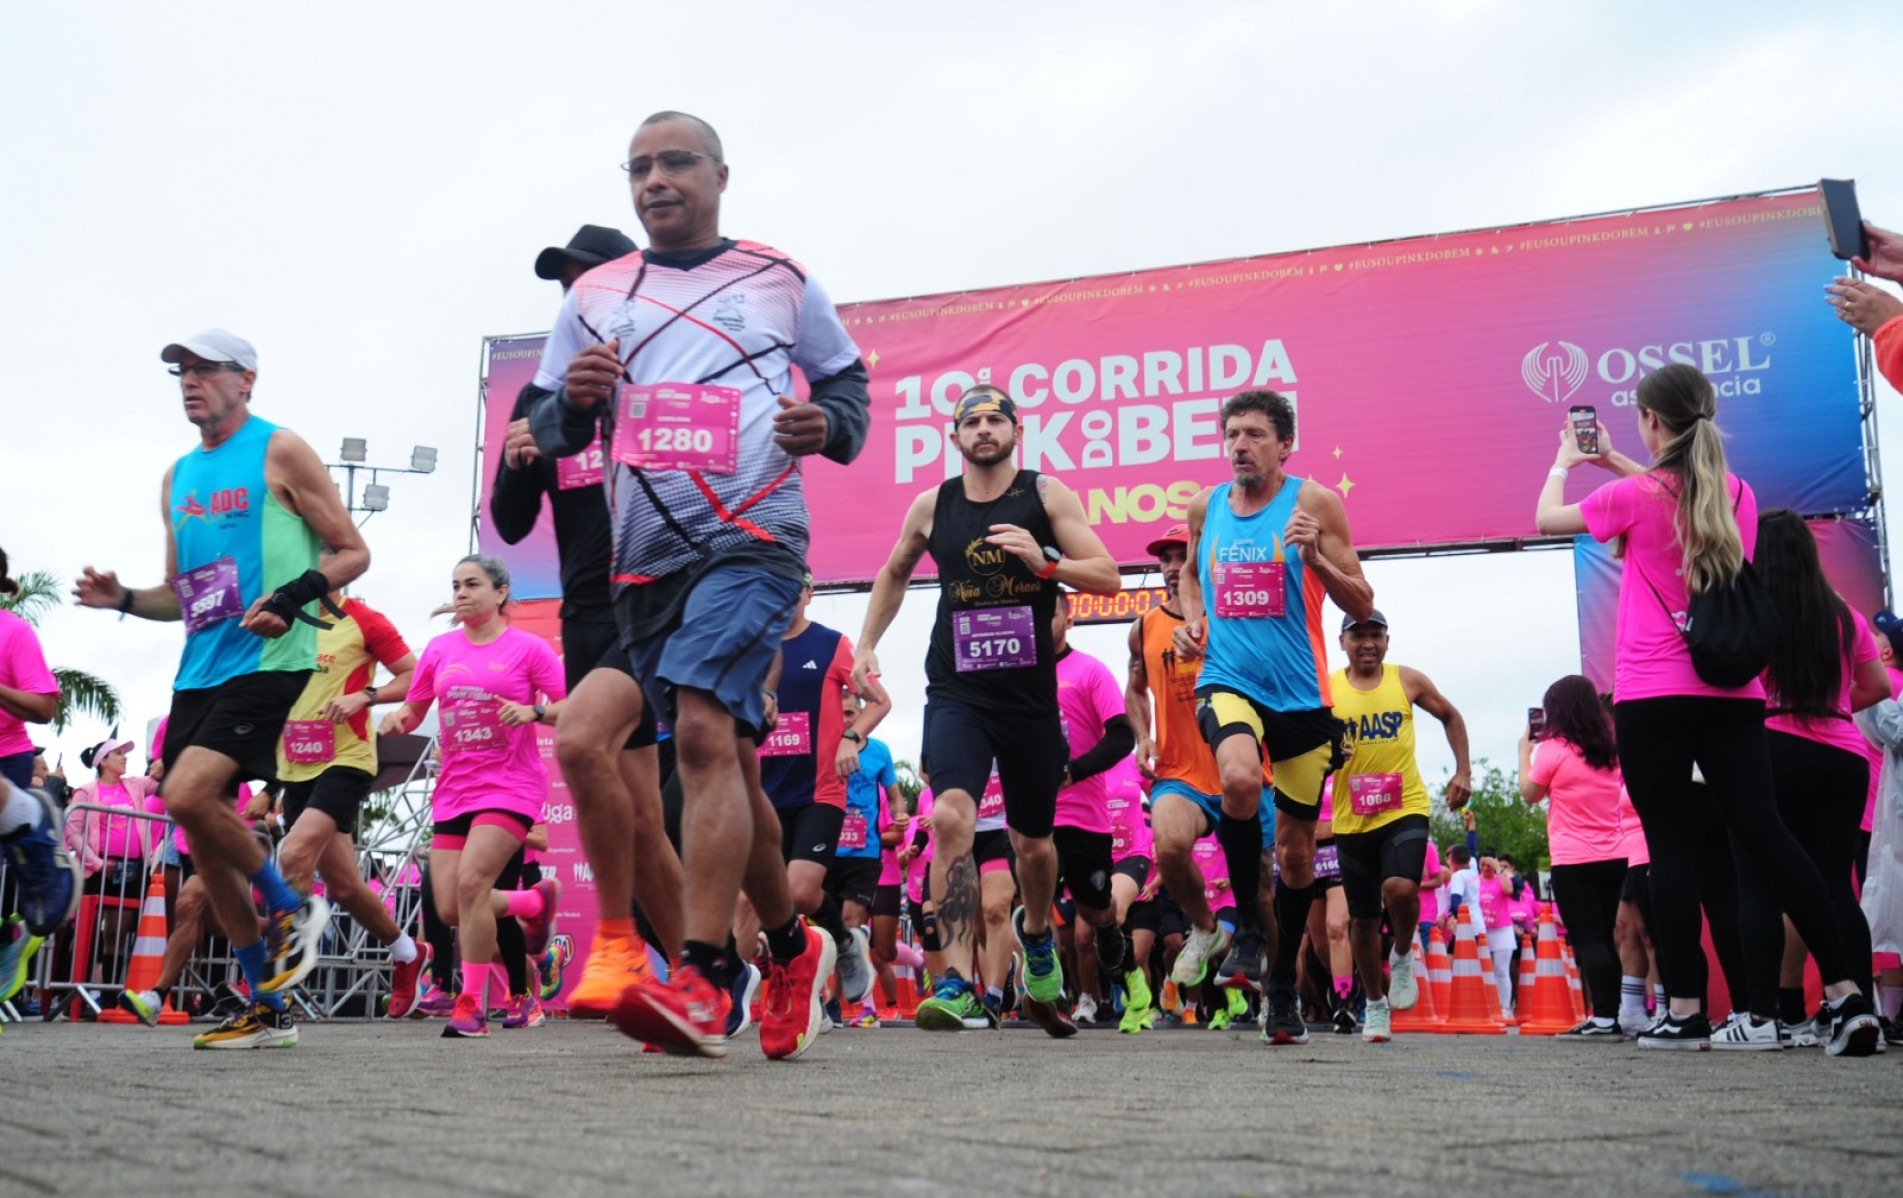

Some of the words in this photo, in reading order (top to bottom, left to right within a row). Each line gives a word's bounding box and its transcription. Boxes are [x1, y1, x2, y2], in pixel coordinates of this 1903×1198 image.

[1700, 205, 1825, 229] #EUSOUPINKDOBE
[1519, 227, 1648, 251] #EUSOUPINKDOBEM
[1348, 248, 1470, 270] #EUSOUPINKDOBEM
[1188, 267, 1304, 288] #EUSOUPINKDOBEM
[492, 348, 545, 361] #EUSOUPIN
[1008, 338, 1298, 409] CORRIDA
[638, 427, 713, 453] 1280
[895, 410, 1077, 484] PIK
[211, 487, 249, 515] ADC
[972, 549, 1003, 566] NM
[1220, 543, 1267, 562] FÊNIX
[1224, 590, 1270, 606] 1309
[969, 638, 1020, 657] 5170
[1360, 711, 1403, 740] AASP
[290, 741, 323, 755] 1240
[768, 733, 800, 747] 1169
